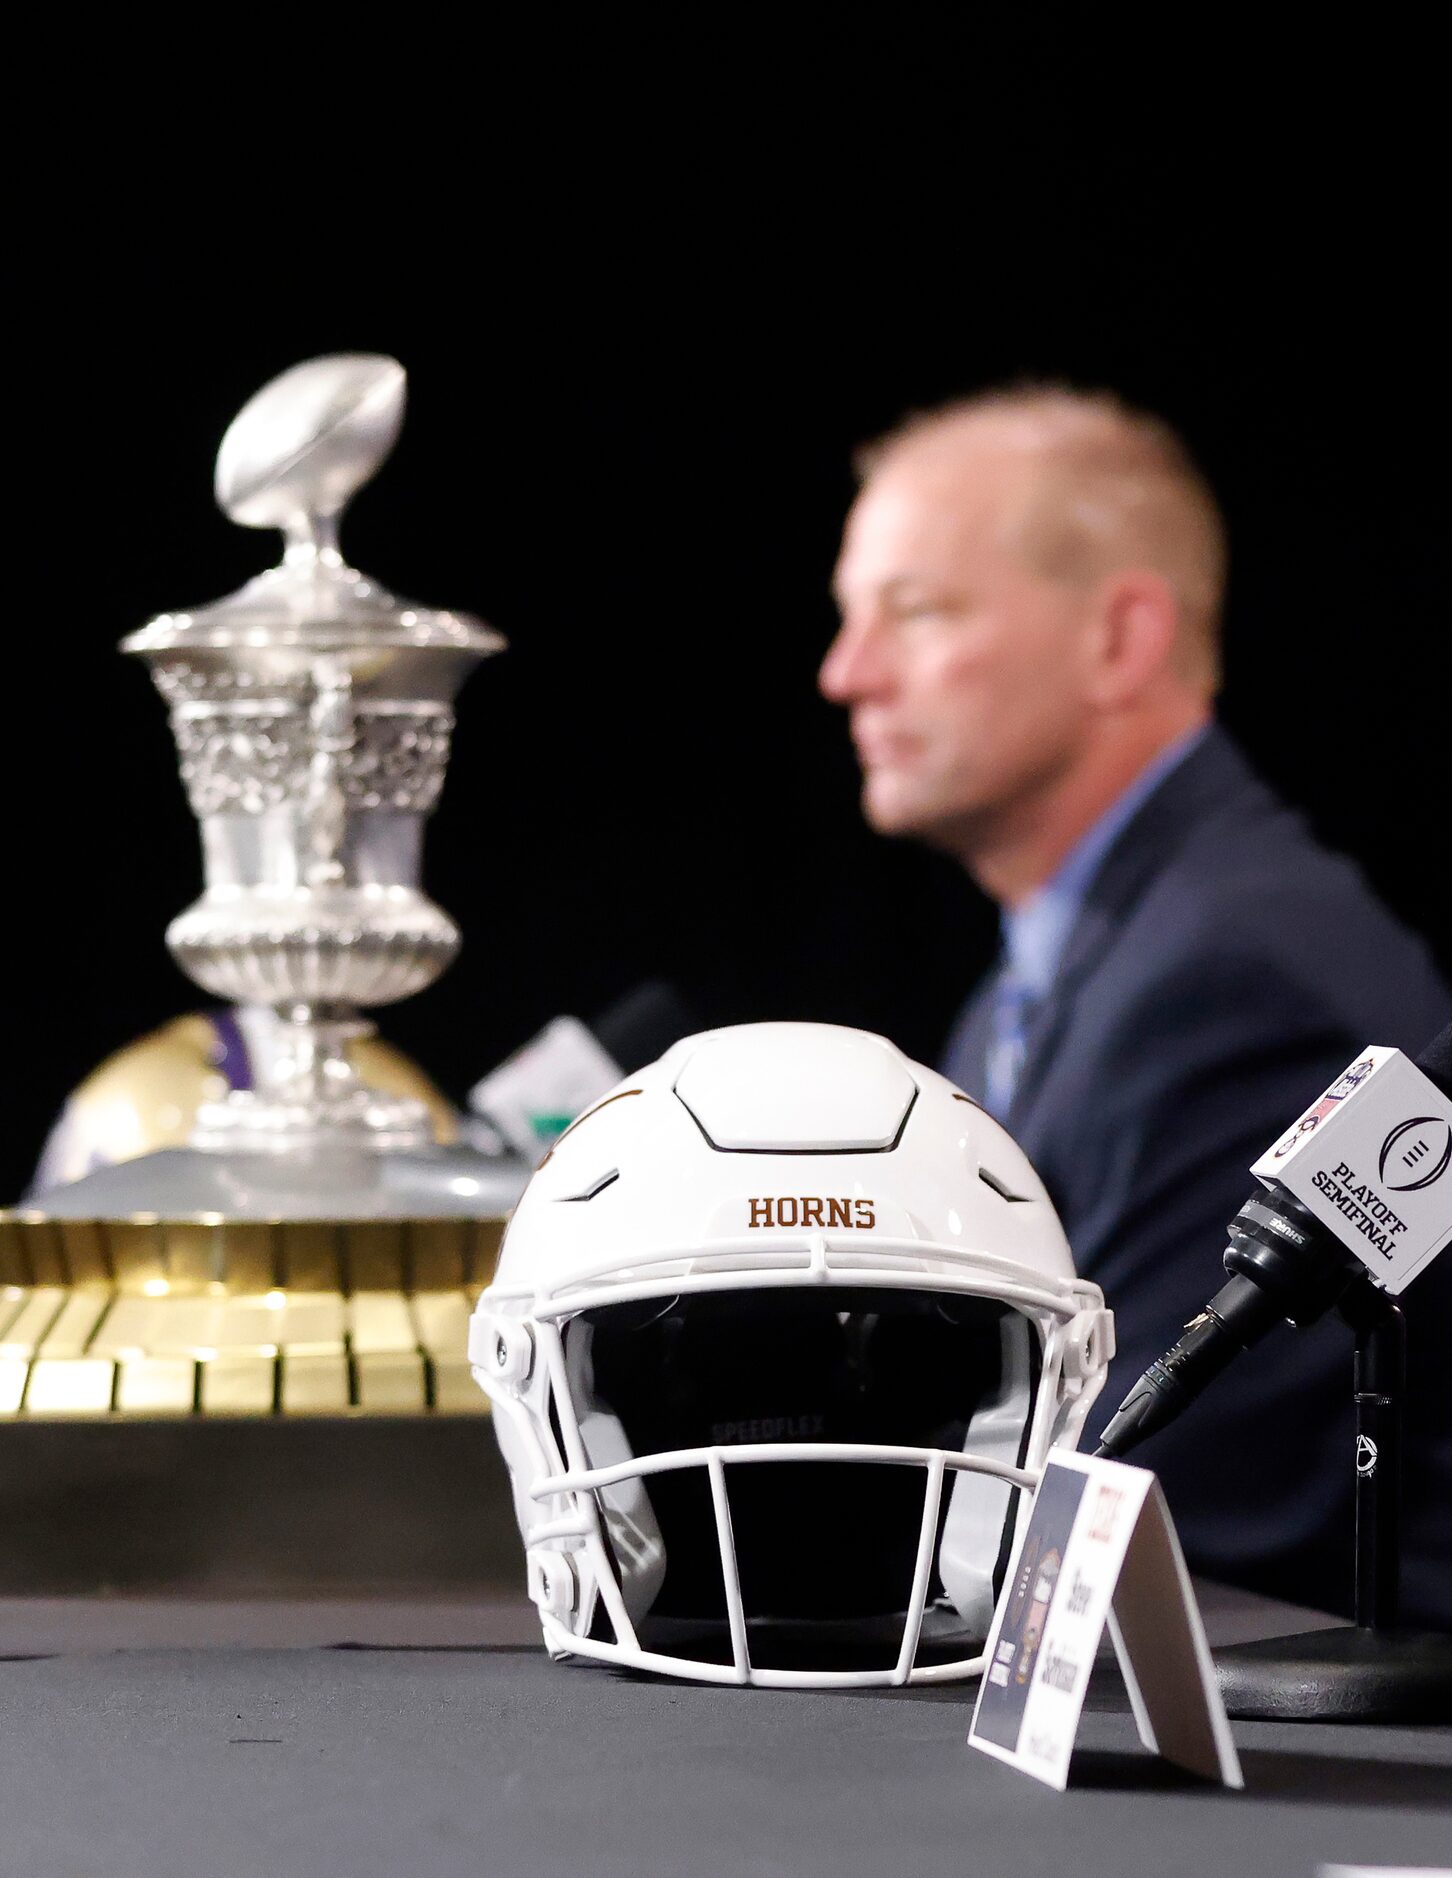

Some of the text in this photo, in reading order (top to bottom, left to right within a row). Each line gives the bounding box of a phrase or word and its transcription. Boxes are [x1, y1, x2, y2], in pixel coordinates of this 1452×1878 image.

[747, 1196, 876, 1229] HORNS
[1312, 1170, 1395, 1261] SEMIFINAL
[1331, 1162, 1408, 1236] PLAYOFF
[1269, 1217, 1305, 1245] SHURE
[711, 1415, 824, 1444] SPEEDFLEX
